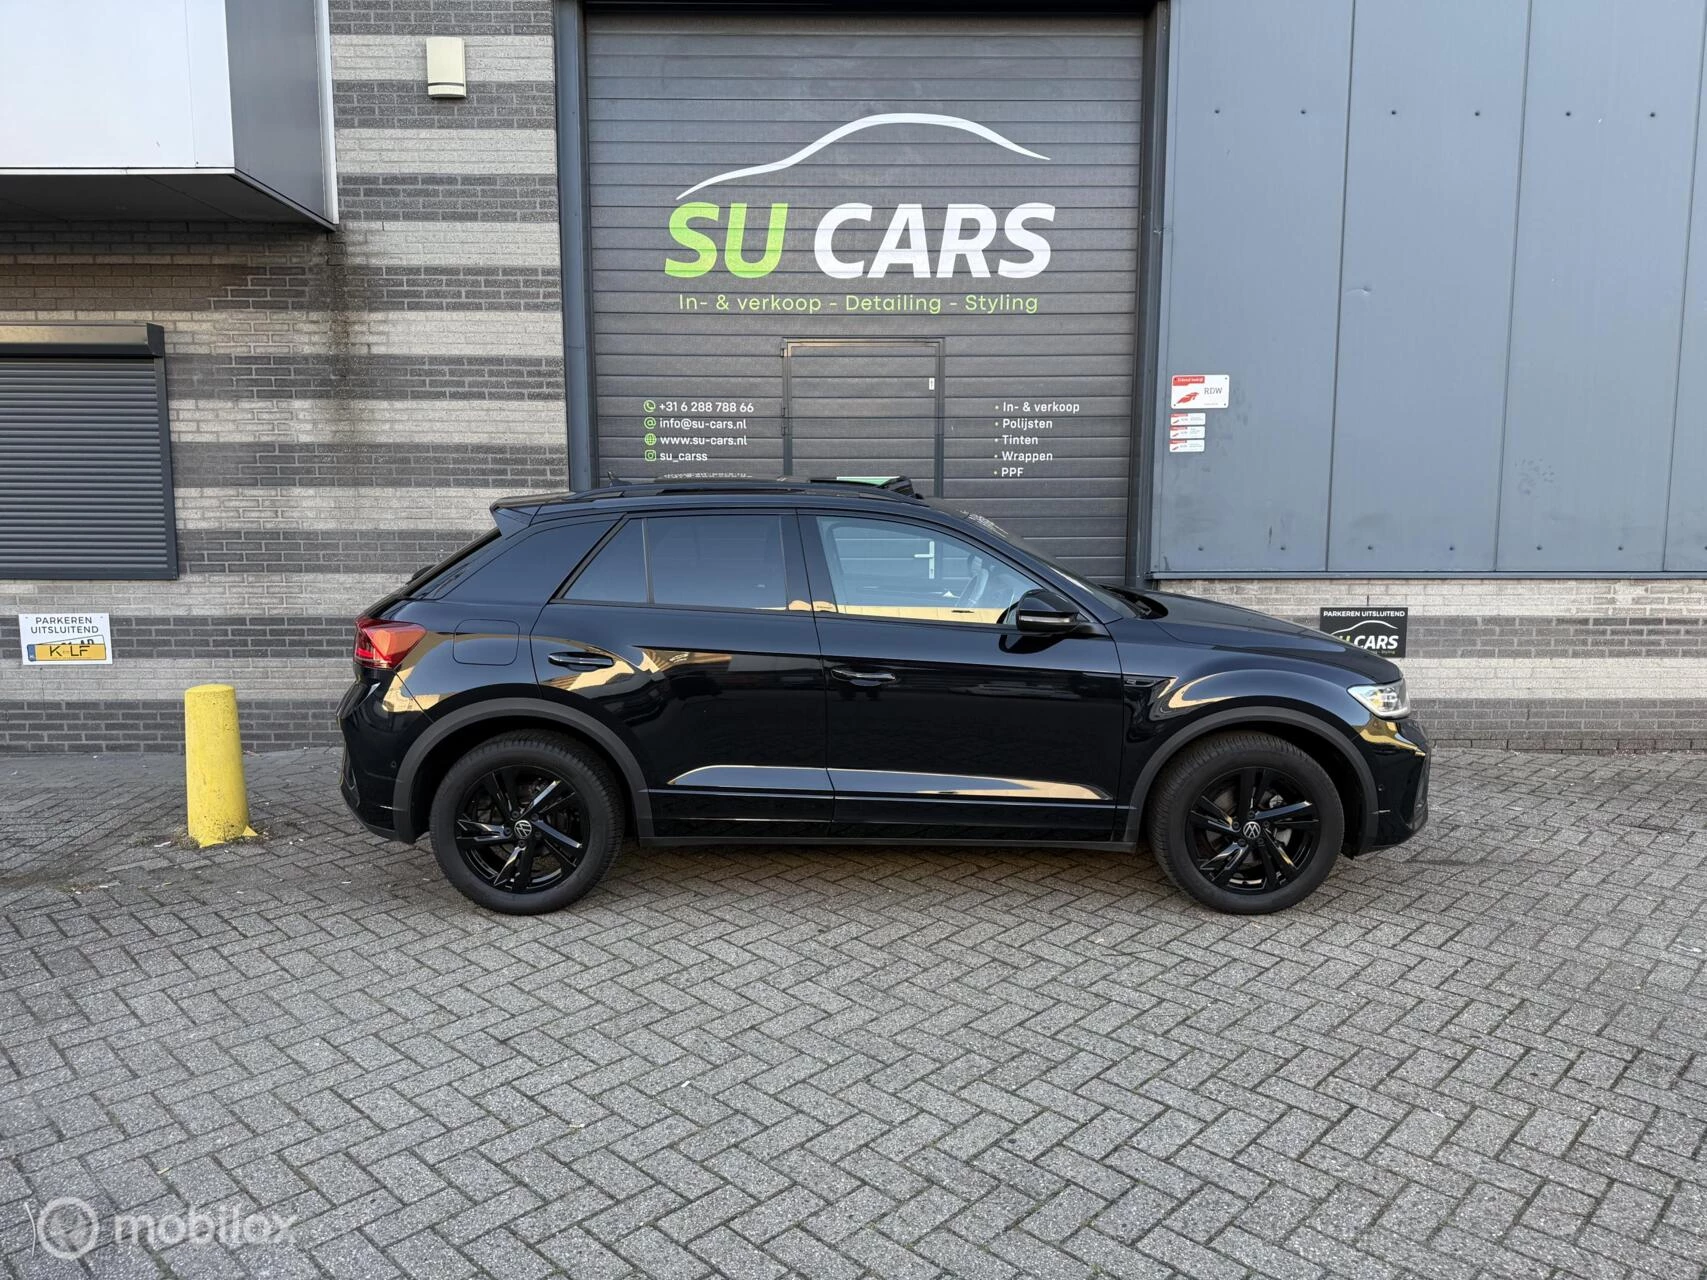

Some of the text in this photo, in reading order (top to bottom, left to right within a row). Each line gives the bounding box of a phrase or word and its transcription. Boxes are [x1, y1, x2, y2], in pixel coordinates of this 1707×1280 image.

[664, 201, 1056, 279] SU CARS
[679, 294, 708, 310] In-
[716, 294, 729, 310] &
[737, 294, 822, 314] verkoop
[846, 295, 941, 314] Detailing
[965, 294, 1039, 314] Styling
[1204, 387, 1223, 395] RDW
[659, 401, 754, 413] +31 6 288 788 66
[1003, 401, 1080, 414] In- & verkoop
[659, 418, 747, 430] info@su-cars.nl
[1002, 418, 1053, 431] Polijsten
[660, 435, 748, 446] www.su-cars.nl
[1002, 434, 1039, 445] Tinten
[660, 452, 708, 463] su_carss
[1001, 451, 1053, 463] Wrappen
[1001, 467, 1024, 477] PPF
[35, 616, 93, 625] PARKEREN
[30, 625, 99, 634] UITSLUITEND
[1353, 635, 1399, 650] CARS
